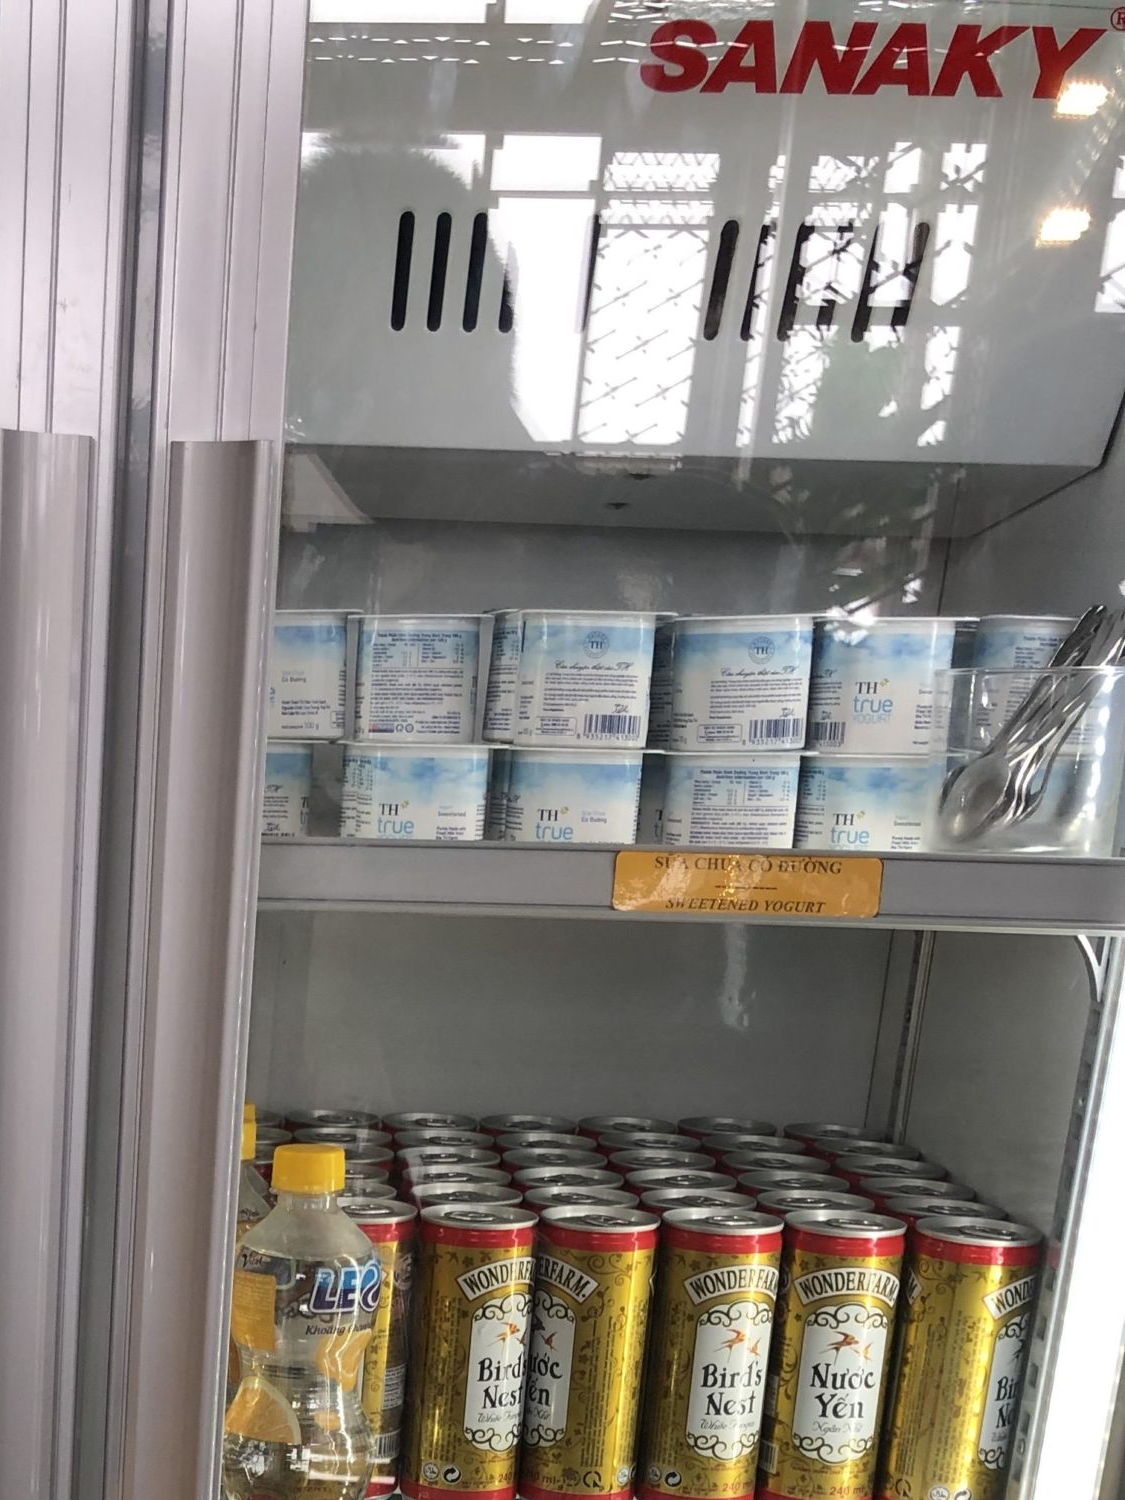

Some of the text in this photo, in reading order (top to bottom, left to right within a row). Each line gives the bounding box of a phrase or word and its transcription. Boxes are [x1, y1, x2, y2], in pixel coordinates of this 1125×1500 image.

[639, 19, 1108, 99] SANAKY
[856, 681, 878, 694] TH
[853, 695, 893, 713] true
[378, 803, 399, 816] TH
[537, 809, 559, 822] TH
[378, 816, 414, 834] true
[833, 813, 854, 826] TH
[535, 823, 573, 840] true
[830, 826, 870, 844] true
[665, 898, 827, 914] SWEETENED YOGURT
[700, 1360, 763, 1390] Bird's
[809, 1362, 876, 1391] Nước
[704, 1391, 757, 1417] Nest
[814, 1392, 865, 1419] Yến
